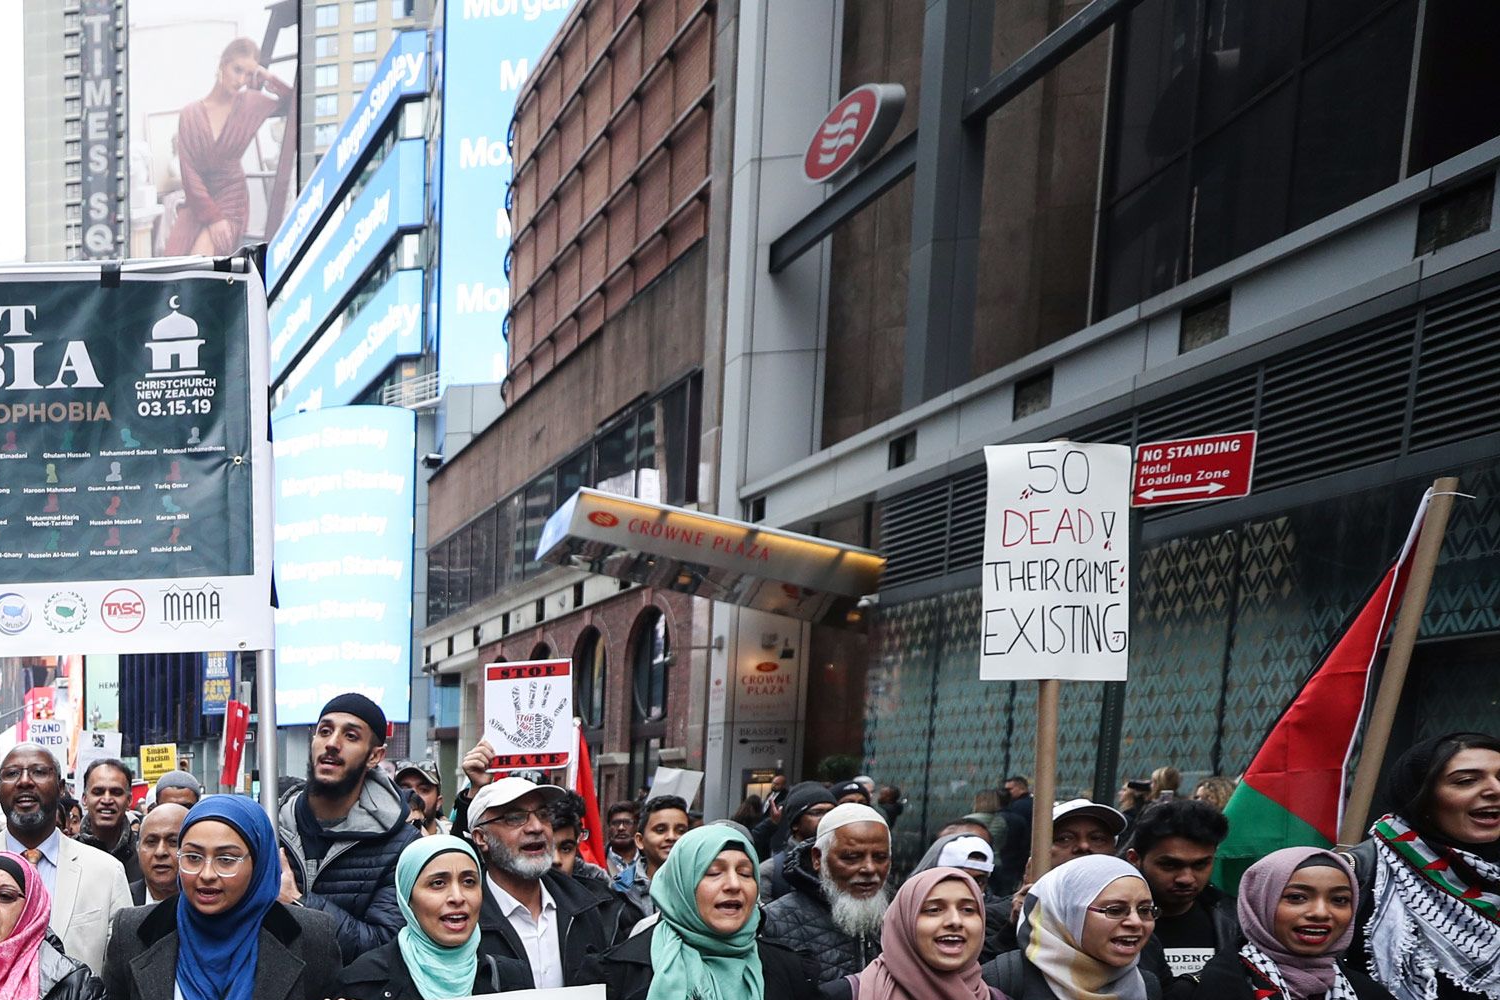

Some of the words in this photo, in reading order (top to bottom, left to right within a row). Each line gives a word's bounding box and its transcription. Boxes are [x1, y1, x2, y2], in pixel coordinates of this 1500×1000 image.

[135, 378, 216, 390] CHRISTCHURCH
[137, 389, 164, 399] NEW
[165, 388, 215, 398] ZEALAND
[137, 399, 212, 417] 03.15.19
[1142, 448, 1162, 463] NO
[1165, 440, 1241, 460] STANDING
[1028, 449, 1090, 495] 50
[1140, 463, 1171, 475] Hotel
[1139, 471, 1192, 487] Loading
[1196, 467, 1231, 481] Zone
[1002, 508, 1116, 551] DEAD!
[628, 518, 705, 547] CROWNE
[712, 535, 770, 561] PLAZA
[985, 558, 1061, 592] THEIR
[163, 591, 220, 621] MANA
[984, 603, 1127, 656] EXISTING
[501, 666, 556, 679] STOP
[742, 674, 791, 685] CROWNE
[747, 685, 785, 695] PLAZA
[31, 722, 61, 734] STAND
[31, 735, 63, 745] UNITED
[146, 747, 169, 755] Smash
[146, 754, 170, 763] Racism
[498, 754, 561, 766] HATE
